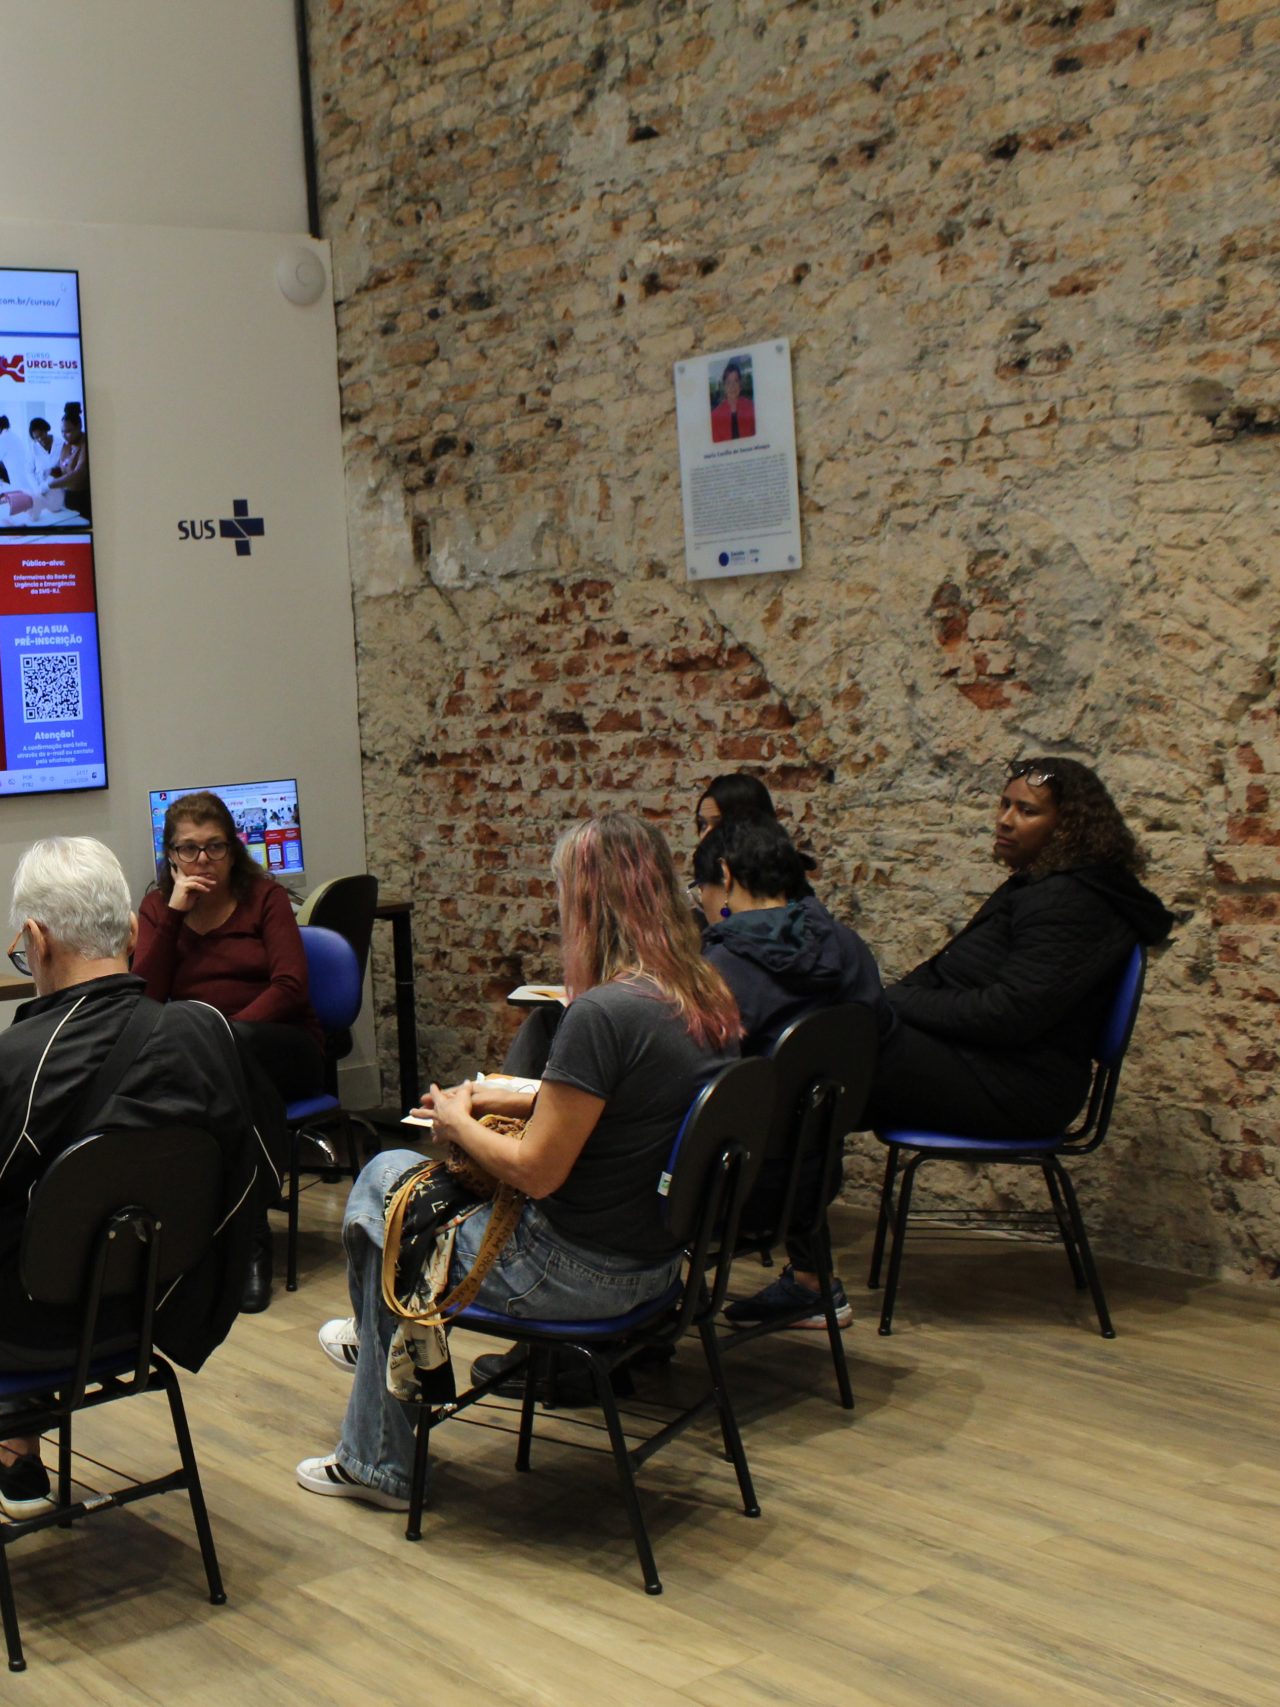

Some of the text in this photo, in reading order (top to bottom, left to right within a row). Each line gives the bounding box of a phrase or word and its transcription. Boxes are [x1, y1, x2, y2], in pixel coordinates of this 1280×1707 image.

[27, 361, 77, 369] URGE-SUS
[178, 520, 215, 540] SUS
[26, 625, 68, 636] FAÇA SUA
[15, 634, 82, 646] PRÉ-INSCRIÇÃO
[35, 729, 74, 741] Atenção!
